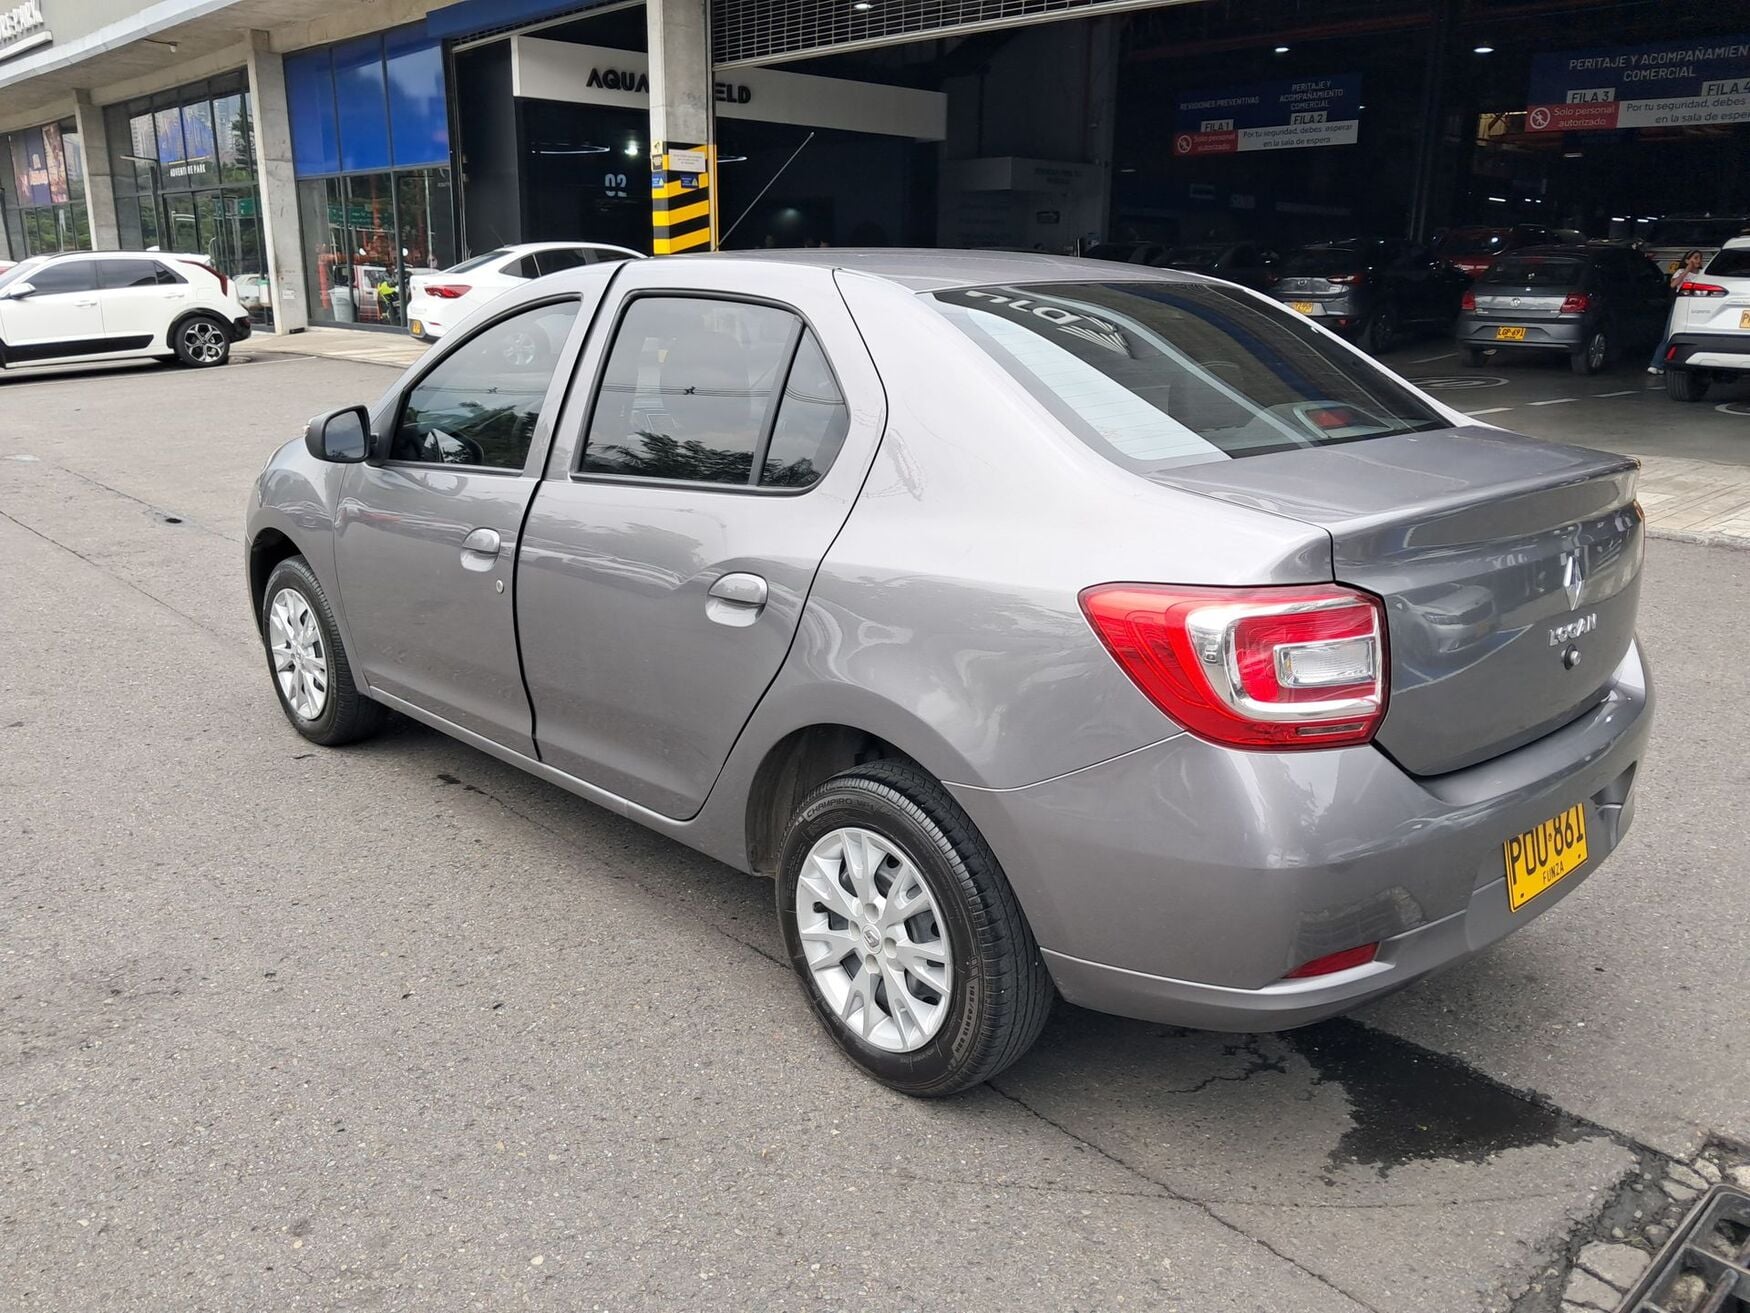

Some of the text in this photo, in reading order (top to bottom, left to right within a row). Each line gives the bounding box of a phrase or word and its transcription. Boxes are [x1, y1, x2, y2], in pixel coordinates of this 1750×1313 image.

[1569, 45, 1750, 71] PERITAJE Y ACOMPAÑAMIEN
[1624, 65, 1697, 81] COMERCIAL
[1707, 83, 1740, 97] FILA
[1571, 91, 1610, 103] FILA 3
[1626, 103, 1642, 112] Por
[1645, 103, 1654, 111] tu
[1711, 97, 1746, 107] debes
[1553, 105, 1616, 117] Solo personal
[1294, 114, 1323, 125] FILA 2
[1558, 118, 1606, 127] autorizado
[1655, 116, 1668, 124] en
[1670, 114, 1679, 123] la
[1682, 113, 1702, 122] sala
[1704, 112, 1718, 121] de
[1205, 122, 1224, 130] FILA
[170, 165, 194, 177] ADVENTRE
[605, 173, 627, 197] 02
[1542, 860, 1565, 885] FUNZA
